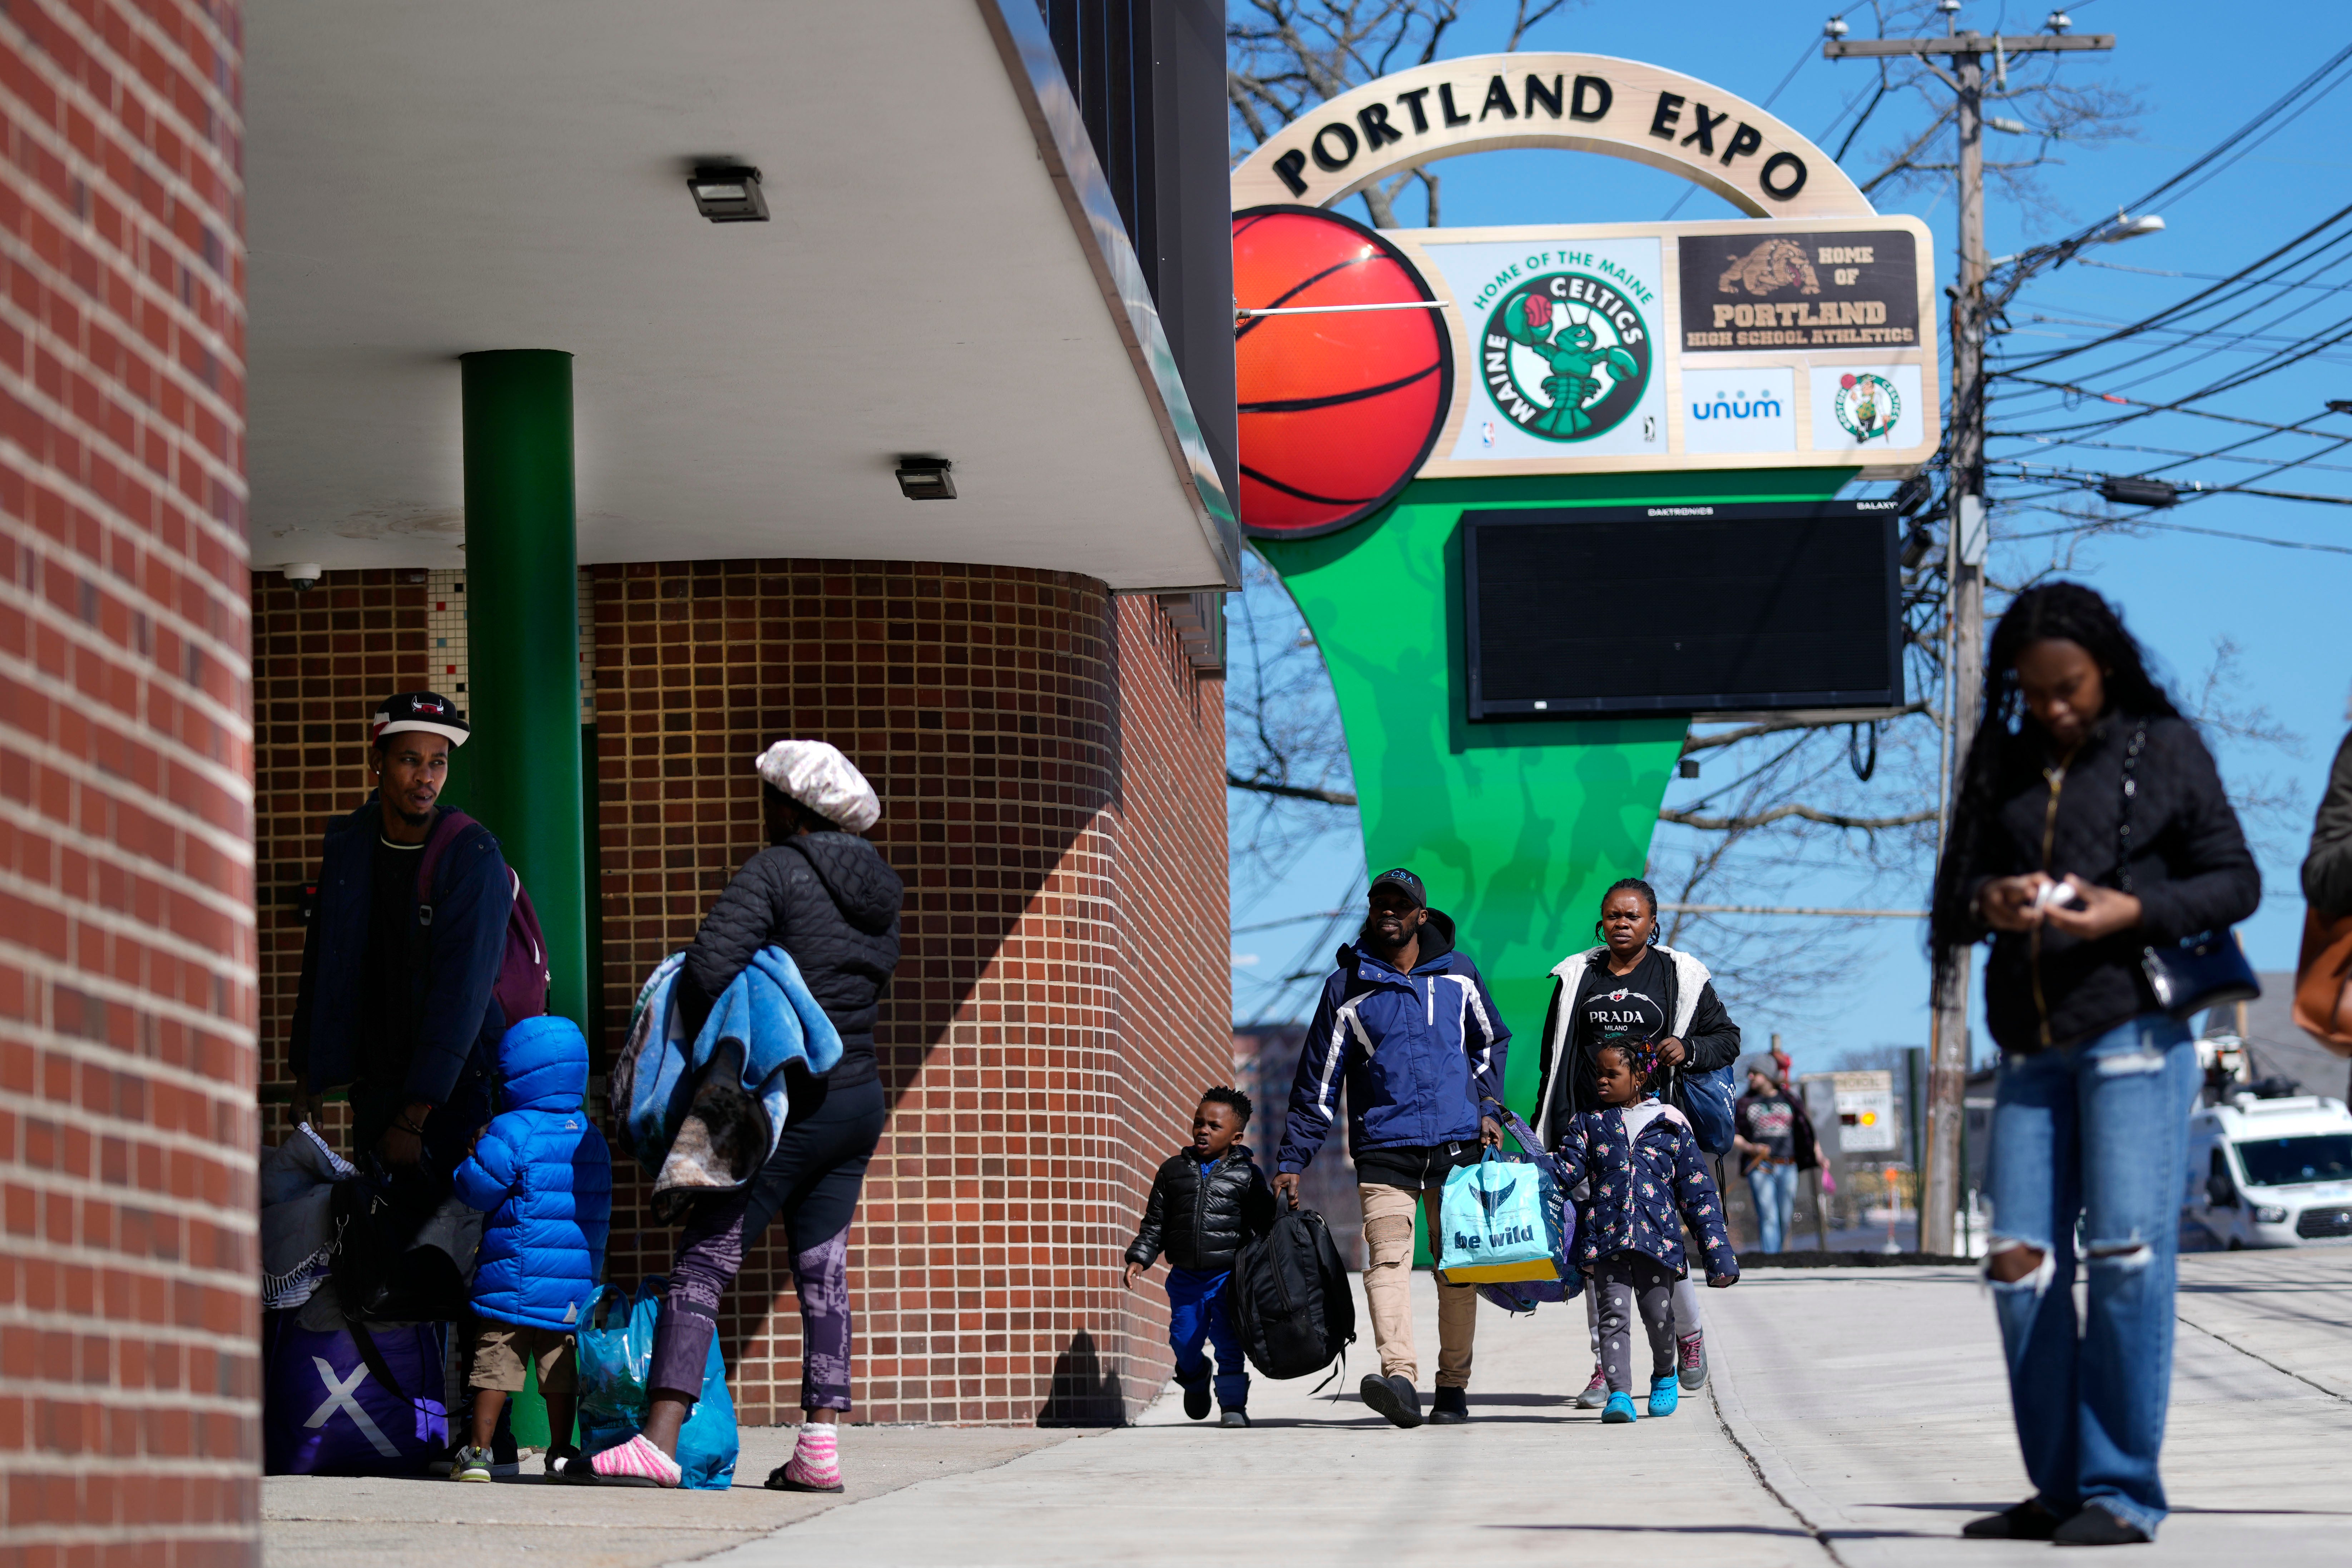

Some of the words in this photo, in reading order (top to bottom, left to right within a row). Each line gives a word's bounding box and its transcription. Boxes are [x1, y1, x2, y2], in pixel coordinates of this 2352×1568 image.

[1272, 74, 1613, 198] PORTLAND
[1649, 91, 1807, 201] EXPO
[1818, 246, 1874, 264] HOME
[1473, 263, 1522, 310] HOME
[1526, 252, 1551, 269] OF
[1558, 251, 1594, 267] THE
[1599, 259, 1654, 305] MAINE
[1834, 268, 1859, 286] OF
[1713, 301, 1886, 328] PORTLAND
[1687, 332, 1733, 347] HIGH
[1736, 330, 1808, 346] SCHOOL
[1811, 327, 1914, 344] ATHLETICS
[1485, 333, 1536, 424] MAINE
[1550, 277, 1643, 345] CELTICS
[1693, 400, 1781, 420] unum
[1648, 507, 1713, 516] DAKTRONICS
[1391, 870, 1414, 885] CSA
[1589, 1011, 1645, 1023] PRADA
[1552, 1193, 1564, 1203] FISH
[1455, 1231, 1481, 1249] be
[1489, 1225, 1534, 1248] wild
